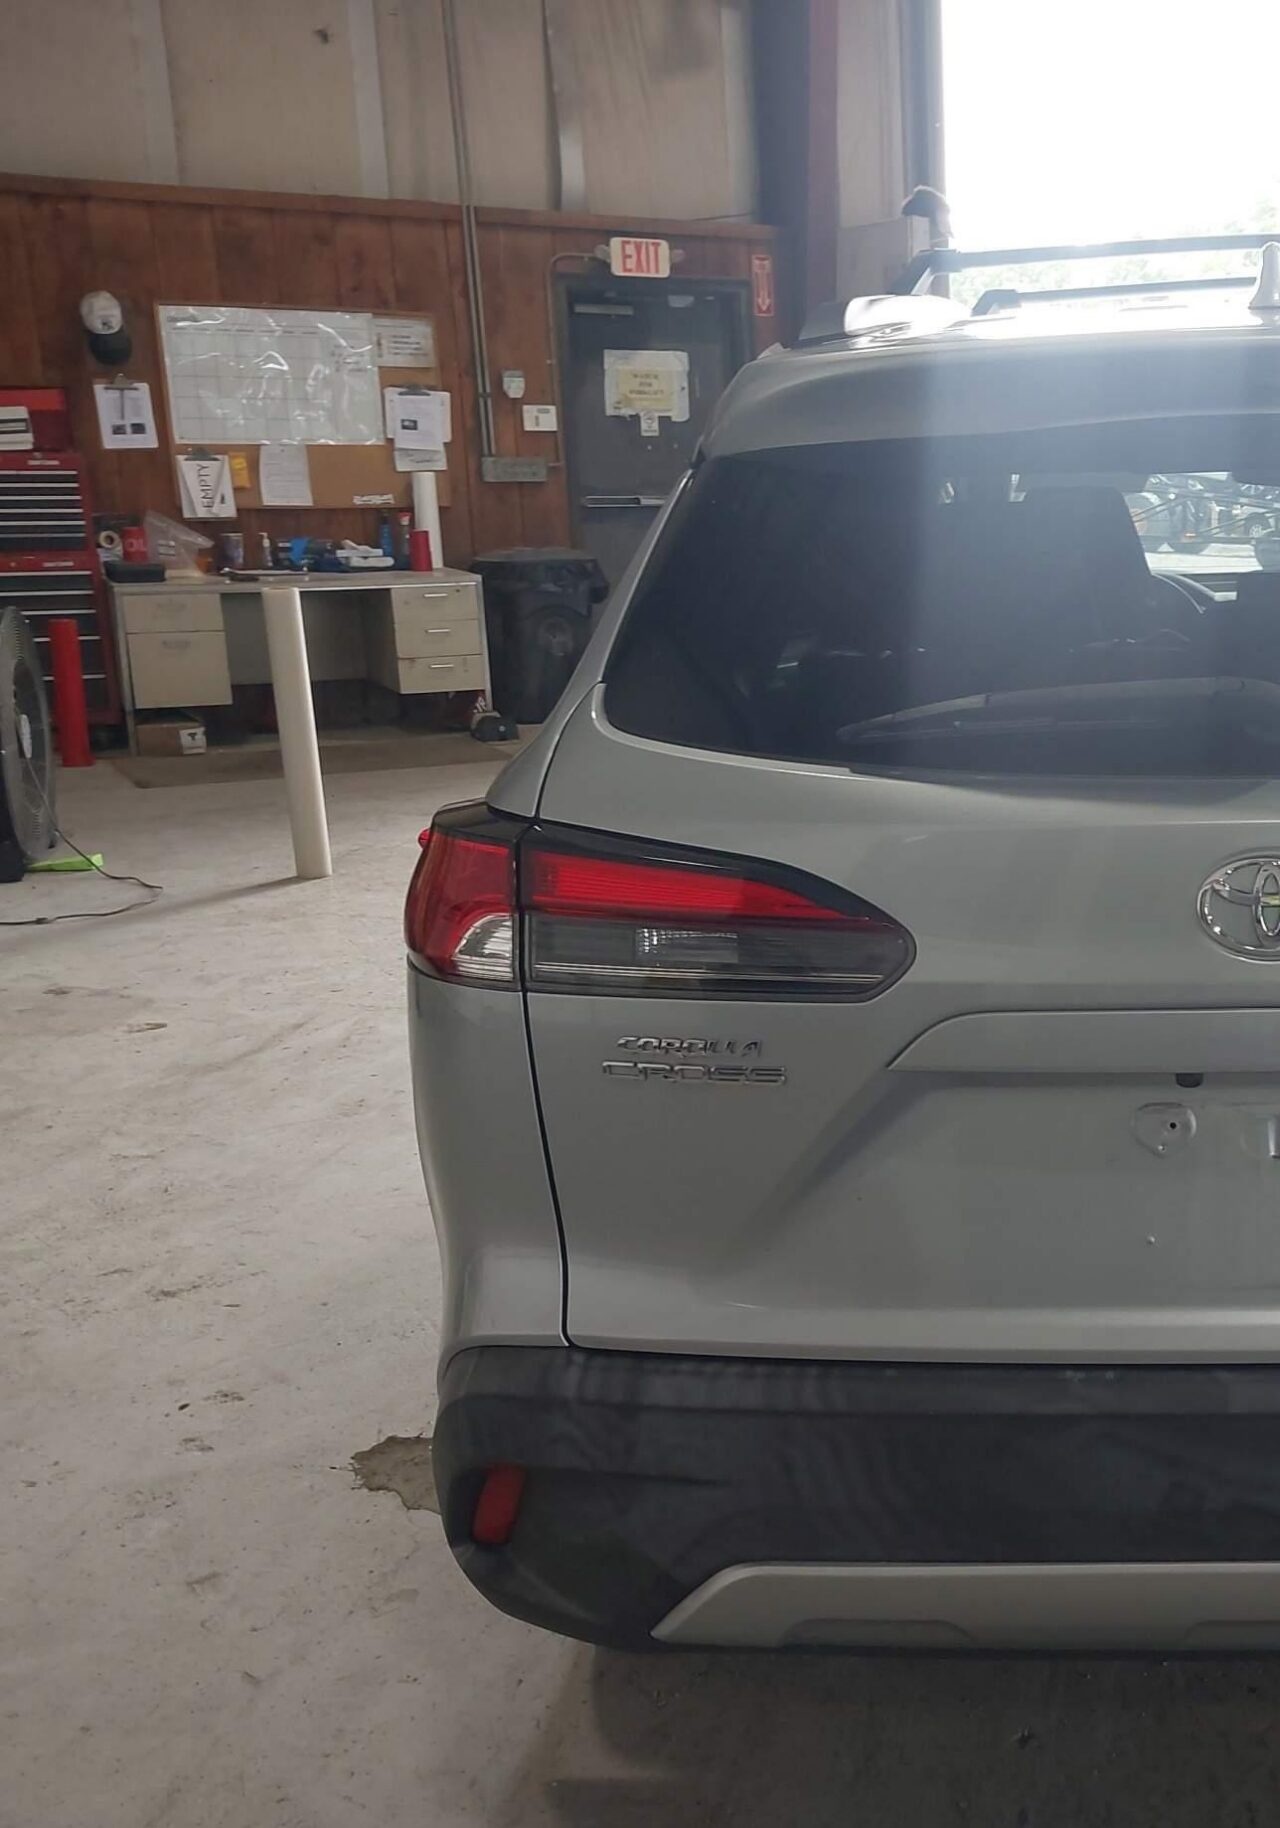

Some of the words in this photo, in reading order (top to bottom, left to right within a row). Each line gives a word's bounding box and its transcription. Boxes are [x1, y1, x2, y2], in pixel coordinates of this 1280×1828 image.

[621, 239, 661, 274] EXIT
[197, 463, 215, 509] EMPTY
[615, 1034, 764, 1059] COROLLA
[601, 1060, 788, 1085] CROSS
